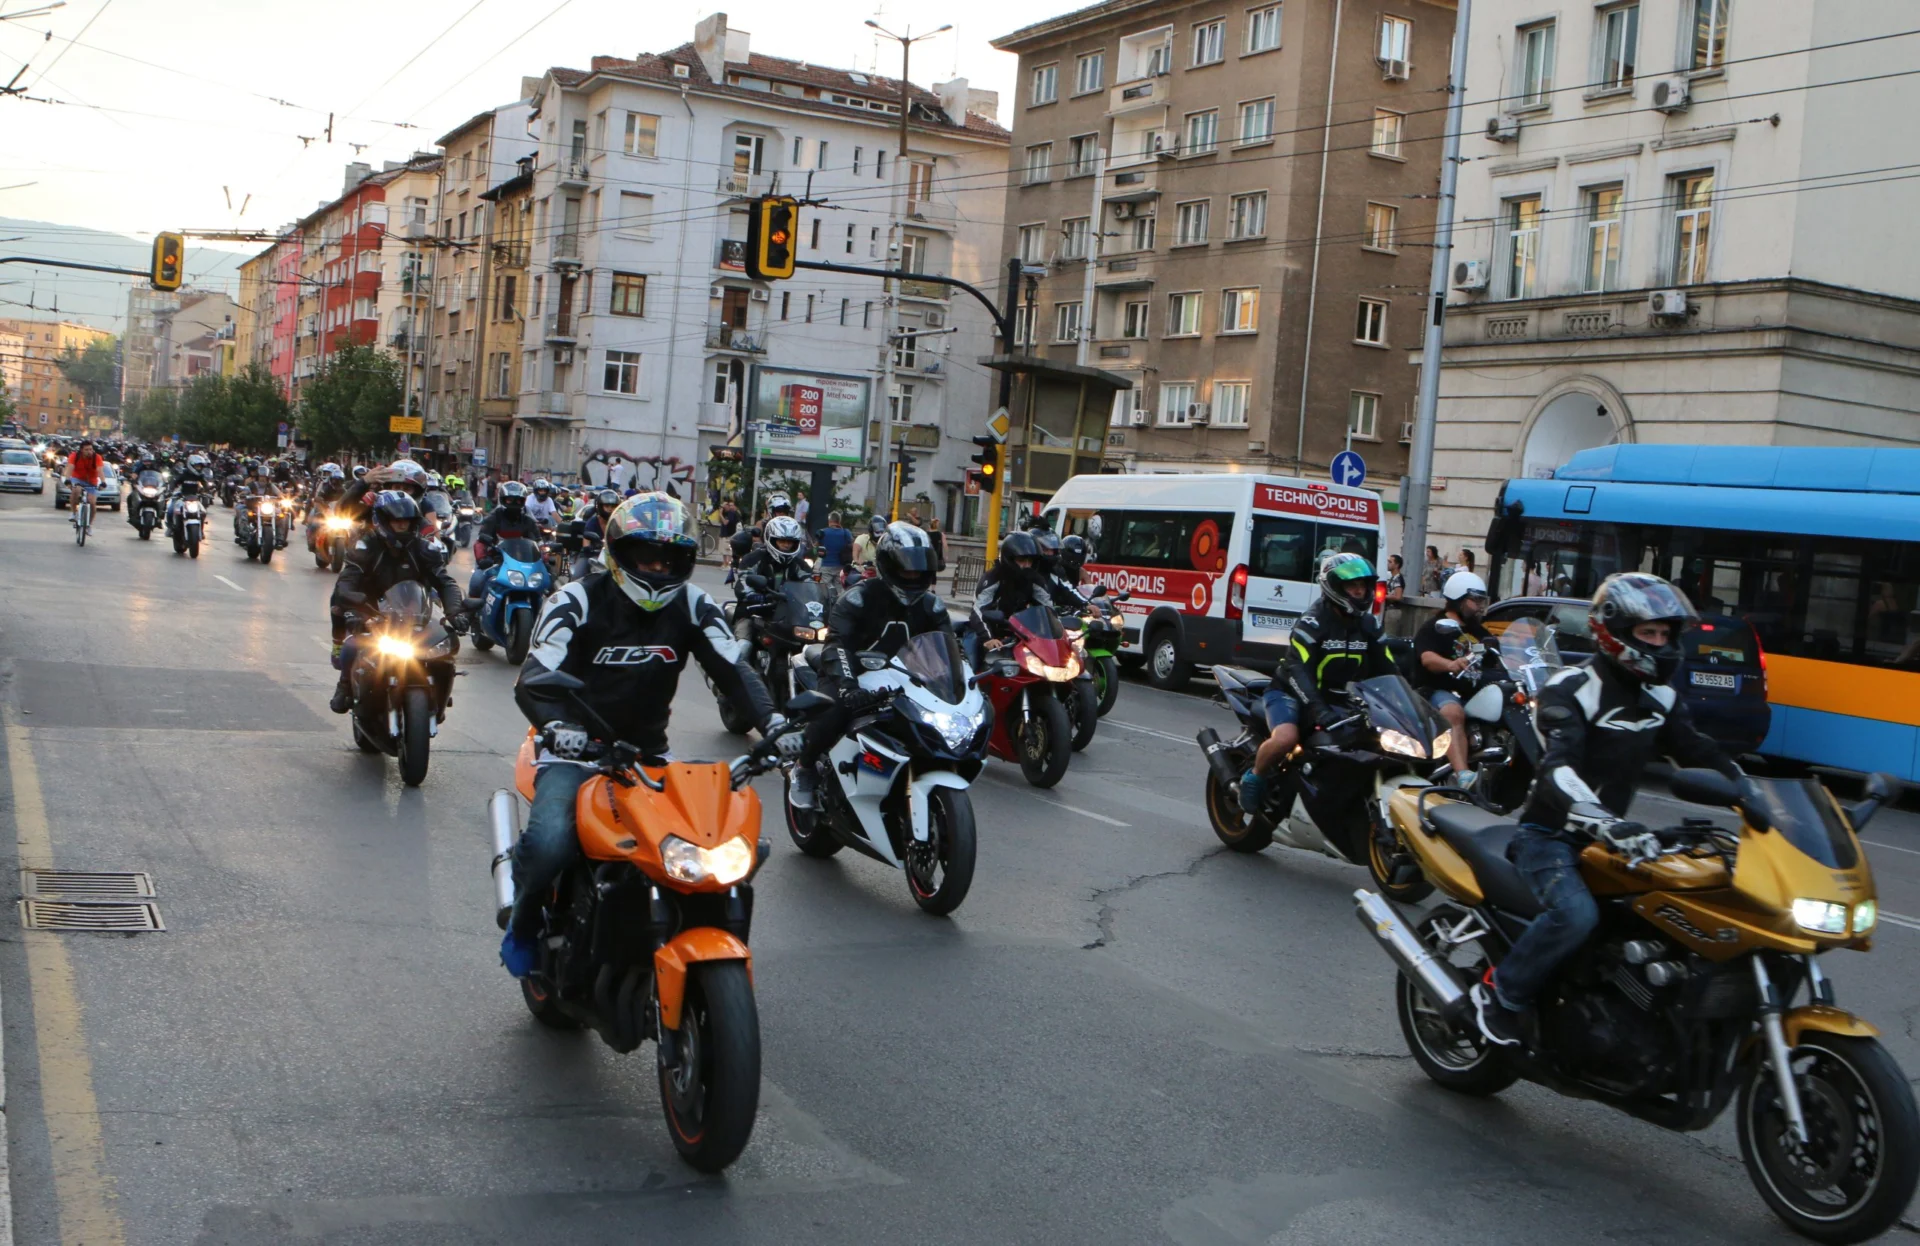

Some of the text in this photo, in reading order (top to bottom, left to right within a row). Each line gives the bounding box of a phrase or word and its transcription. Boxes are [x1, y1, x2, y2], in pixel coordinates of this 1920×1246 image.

[801, 389, 819, 400] 200
[842, 393, 858, 401] NOW
[799, 404, 818, 414] 200
[1265, 487, 1368, 513] TECHNOPOLIS
